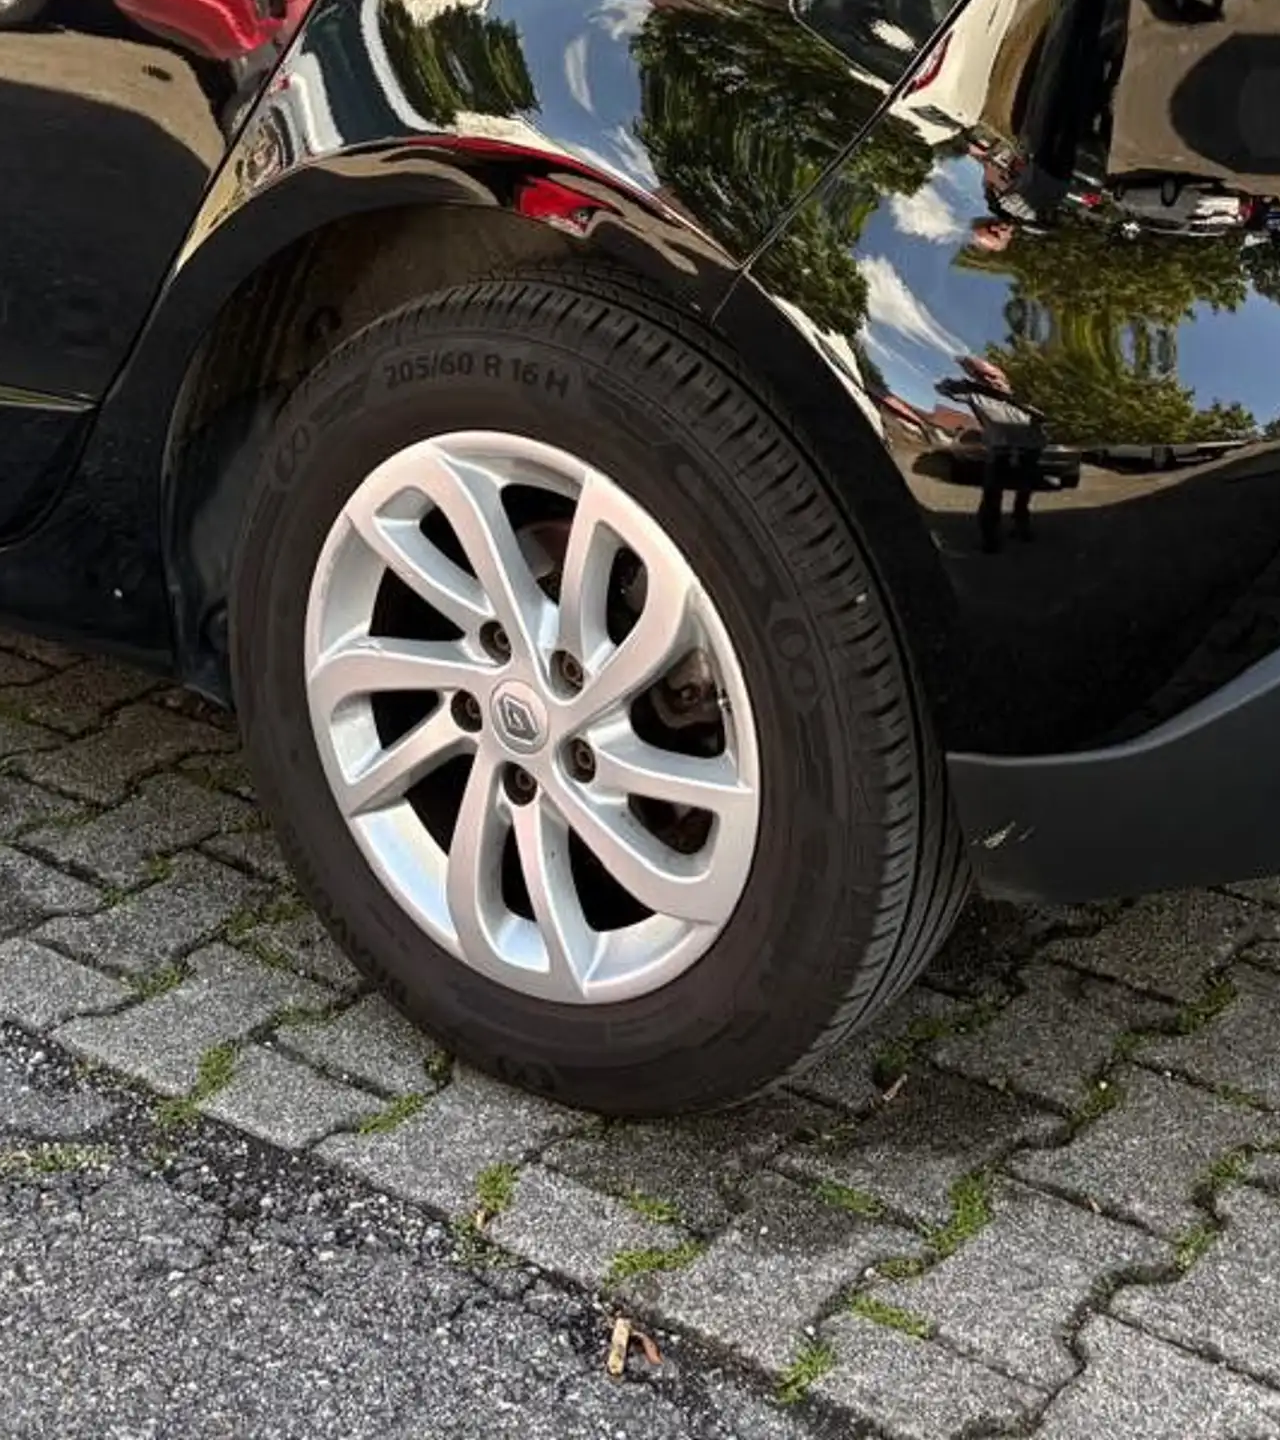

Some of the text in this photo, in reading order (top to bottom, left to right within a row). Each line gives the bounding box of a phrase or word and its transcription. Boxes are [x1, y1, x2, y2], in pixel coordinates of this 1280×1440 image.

[383, 350, 570, 399] 205/60 R 16 H
